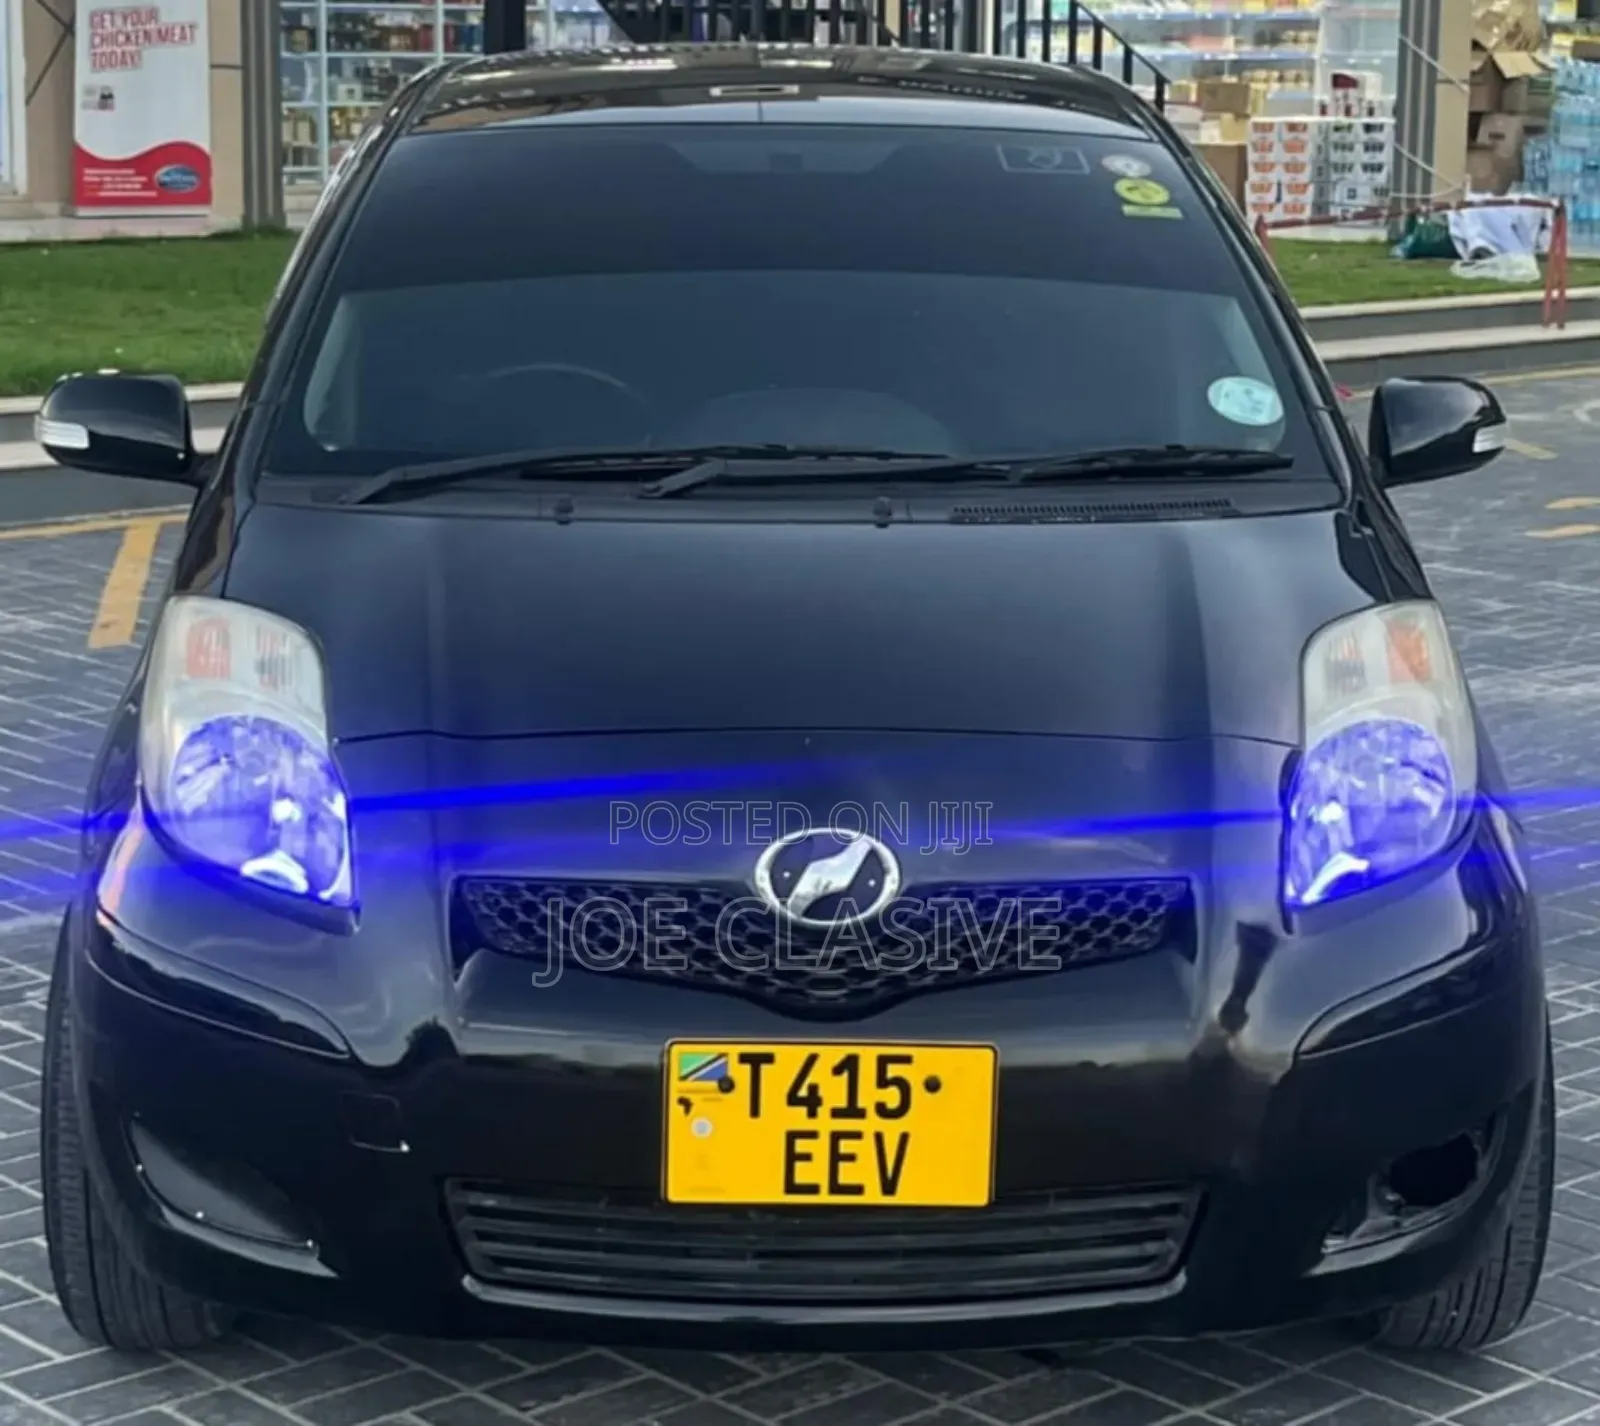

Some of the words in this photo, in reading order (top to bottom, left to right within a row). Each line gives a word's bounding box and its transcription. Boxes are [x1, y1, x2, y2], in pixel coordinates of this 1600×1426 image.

[90, 10, 116, 30] GET
[120, 8, 158, 27] YOUR
[90, 28, 152, 50] CHICKEN
[157, 24, 197, 45] MEAT
[91, 50, 142, 70] TODAY!
[738, 1052, 775, 1119] T
[786, 1053, 914, 1120] 415
[784, 1130, 911, 1197] EEV
